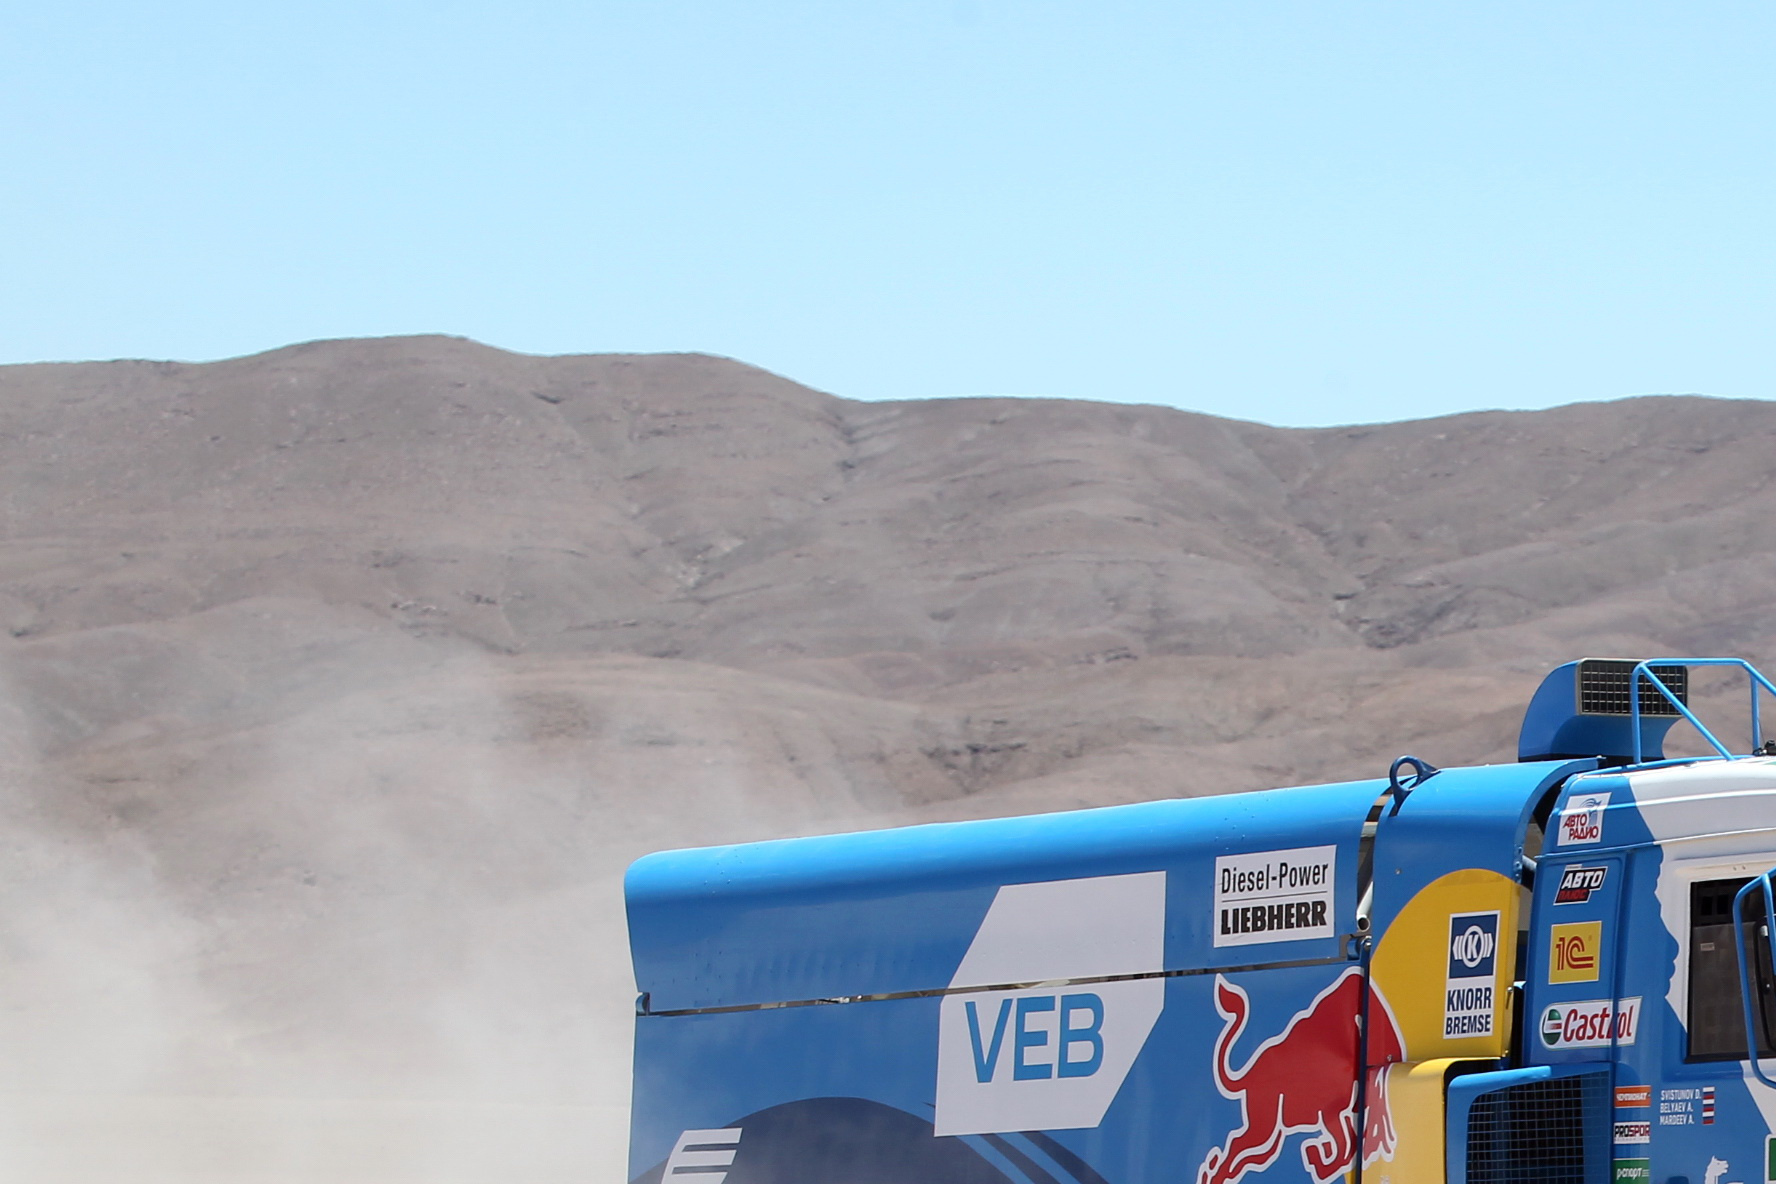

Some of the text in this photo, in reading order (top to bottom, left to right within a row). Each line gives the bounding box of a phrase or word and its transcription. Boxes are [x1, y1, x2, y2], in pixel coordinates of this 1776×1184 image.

[1563, 814, 1587, 828] АВТО
[1569, 825, 1599, 840] РАДИО
[1221, 862, 1328, 894] Diesel-Power
[1561, 870, 1603, 889] АВТО
[1221, 900, 1327, 935] LIEBHERR
[1447, 986, 1492, 1012] KNORR
[1445, 1014, 1491, 1036] BREMSE
[1563, 1005, 1633, 1042] Castrol
[965, 992, 1105, 1084] VEB
